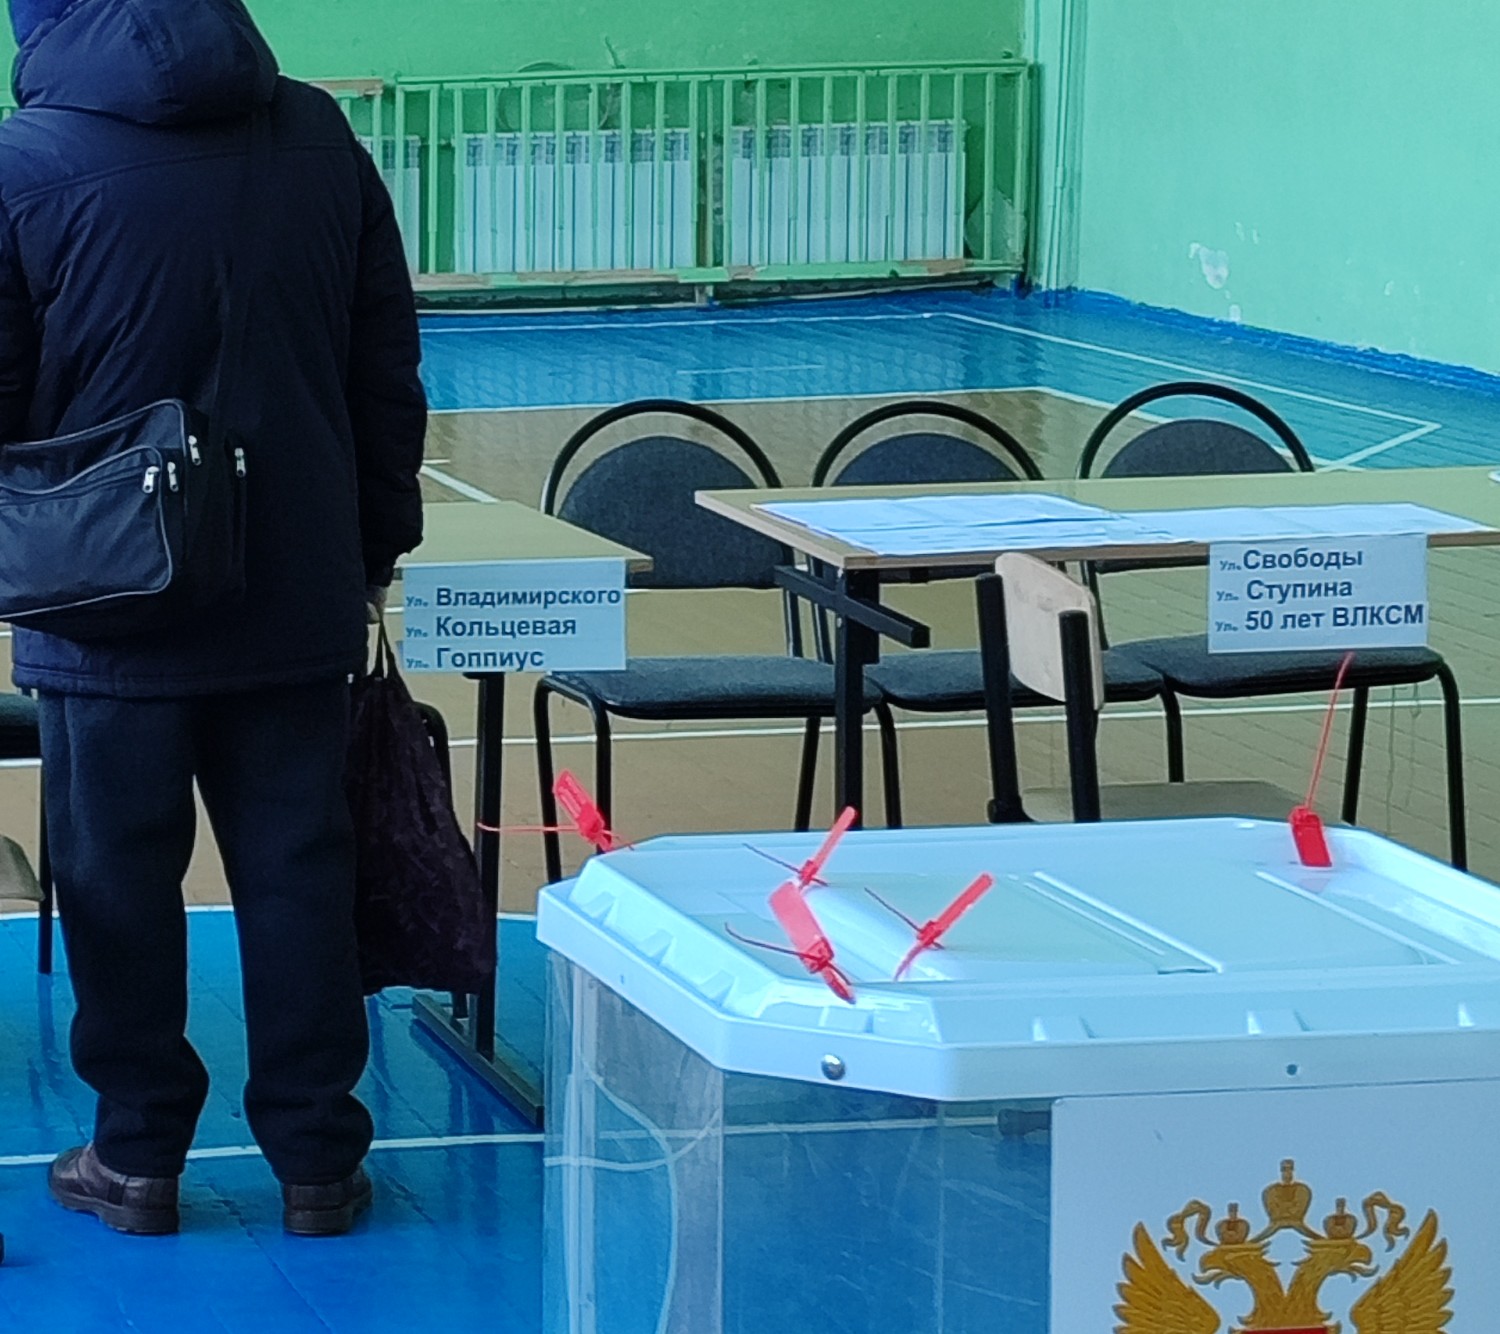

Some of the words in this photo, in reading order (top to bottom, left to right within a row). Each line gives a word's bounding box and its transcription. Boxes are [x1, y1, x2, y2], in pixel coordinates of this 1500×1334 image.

[1243, 547, 1363, 571] Свободы
[436, 587, 622, 609] Владимирского
[1246, 579, 1353, 604] Ступина
[436, 616, 576, 639] Кольцевая
[1245, 609, 1273, 631] 50
[1280, 612, 1326, 630] лет
[1332, 604, 1425, 627] ВЛКСМ
[436, 648, 545, 672] Гоппиус
